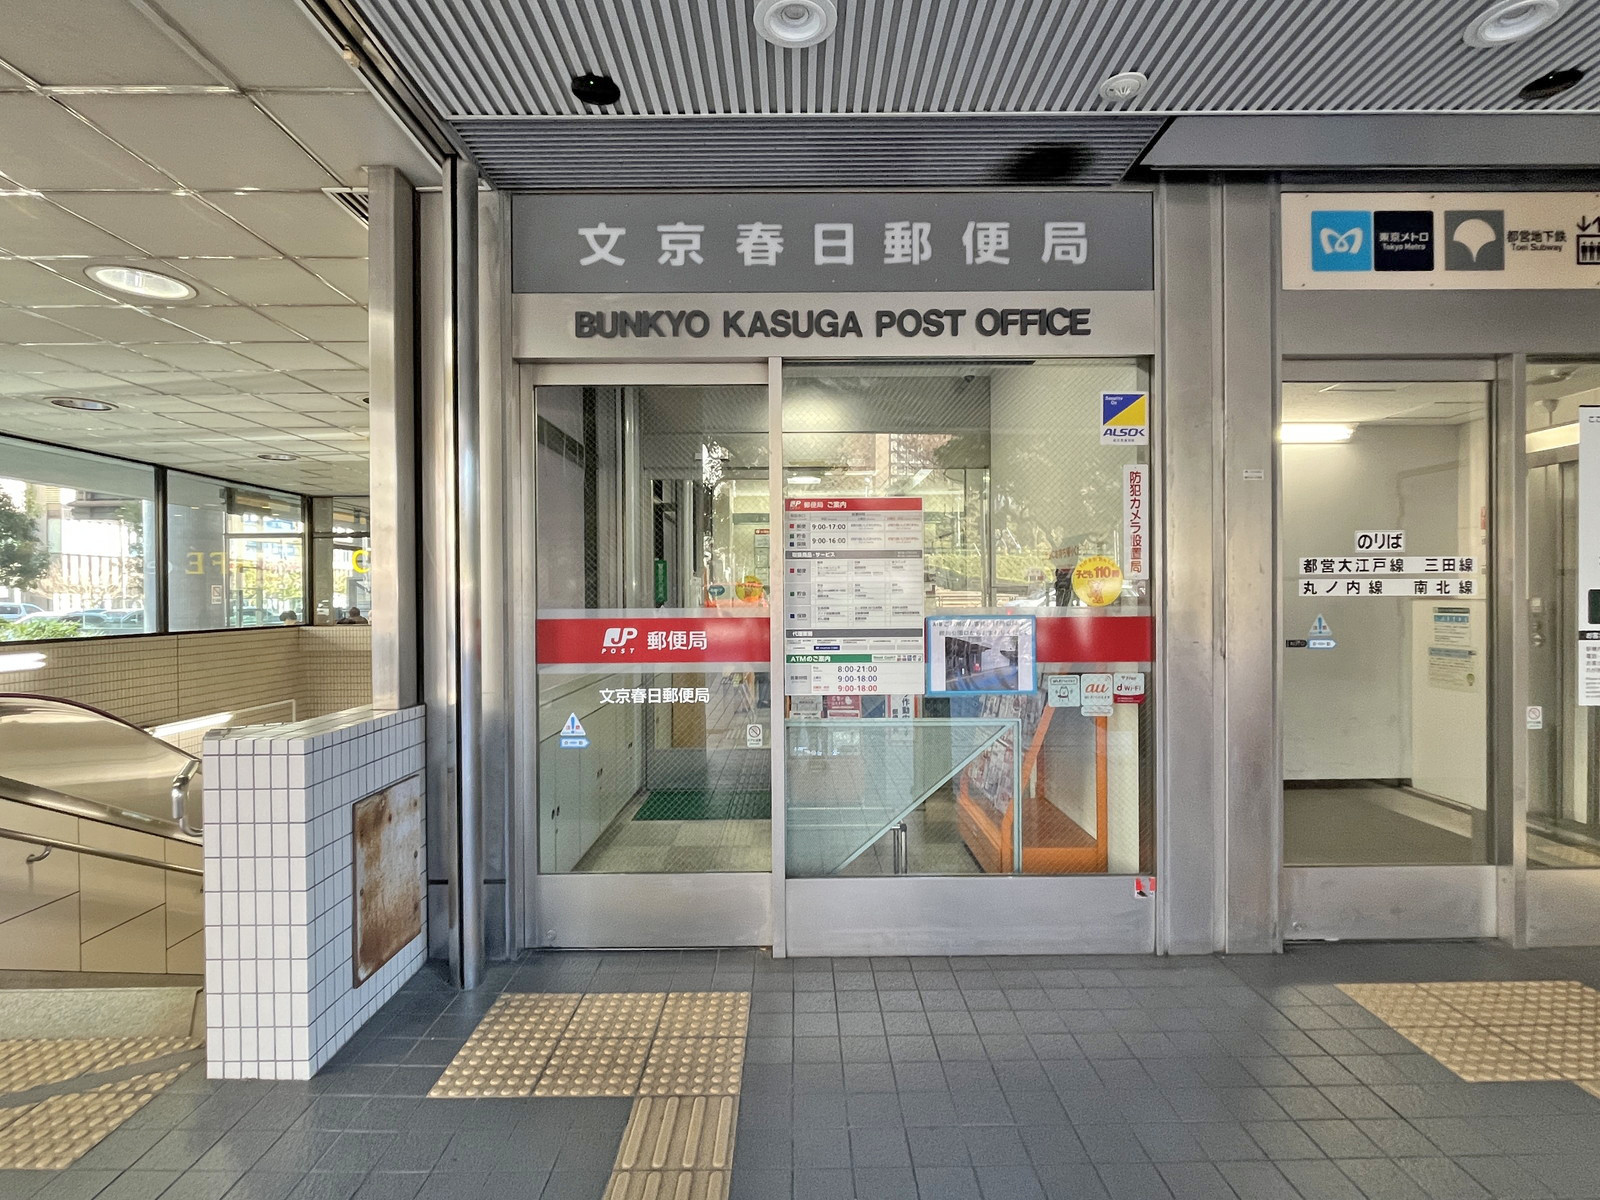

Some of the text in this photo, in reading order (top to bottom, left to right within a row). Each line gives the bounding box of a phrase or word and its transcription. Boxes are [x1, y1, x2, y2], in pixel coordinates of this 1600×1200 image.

[1379, 232, 1429, 242] 東京メトロ
[1507, 230, 1567, 243] 都営地下鉄
[578, 221, 1088, 267] 文京春日郵便局
[1382, 243, 1403, 252] Tokyo
[1511, 243, 1563, 252] Toei Subway
[575, 307, 1091, 338] BUNKYO KASUGA POST OFFICE
[1103, 428, 1145, 437] ALSOK
[1129, 471, 1142, 573] 防犯カメラ設置局
[1357, 533, 1403, 549] のりば
[1303, 558, 1473, 573] 都営大江戸線 三田線
[1303, 580, 1473, 595] 丸ノ内線 南北線
[647, 631, 708, 650] 郵便局
[837, 665, 878, 673] 8:00-21:00
[837, 684, 878, 692] 9:00-18:00
[1085, 683, 1109, 694] au
[599, 687, 710, 704] 文京春日郵便局
